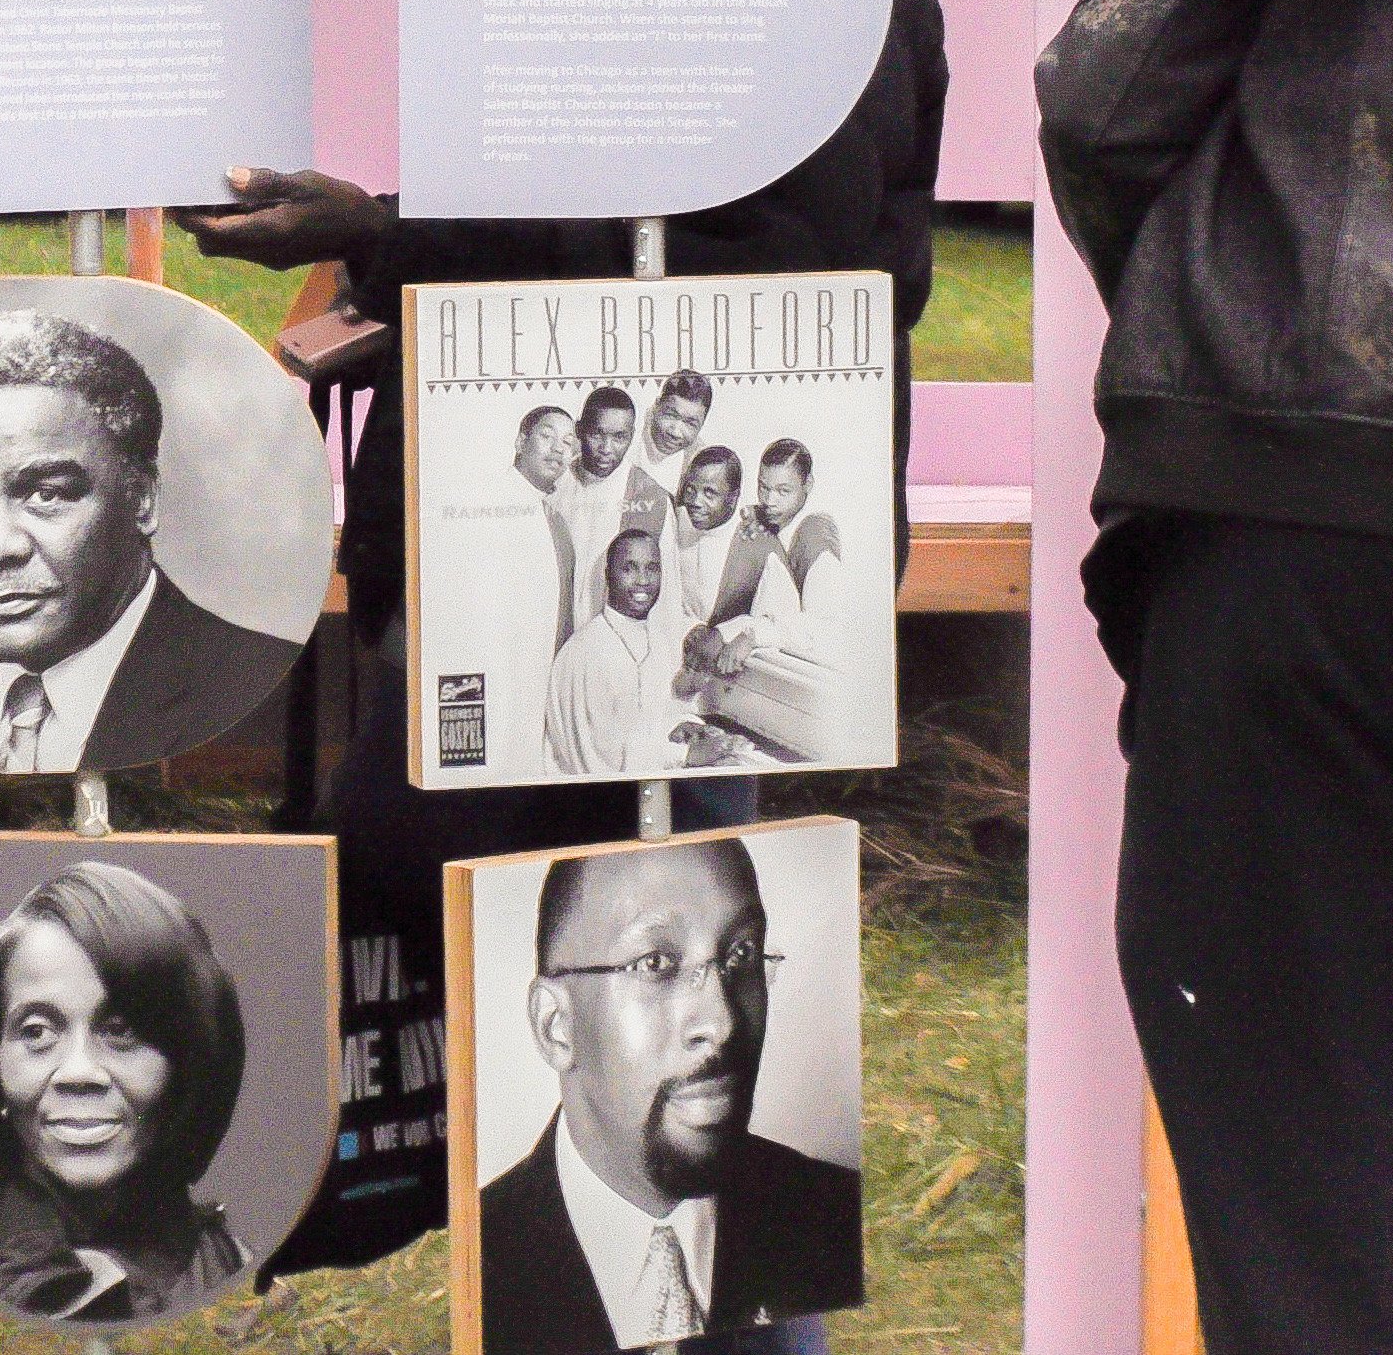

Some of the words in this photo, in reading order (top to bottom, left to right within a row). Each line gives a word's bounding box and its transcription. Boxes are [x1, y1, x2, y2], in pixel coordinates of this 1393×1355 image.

[439, 297, 563, 378] ALEX
[600, 288, 871, 374] BRADFORD
[441, 504, 537, 521] RAINBOW
[617, 497, 655, 515] SKY
